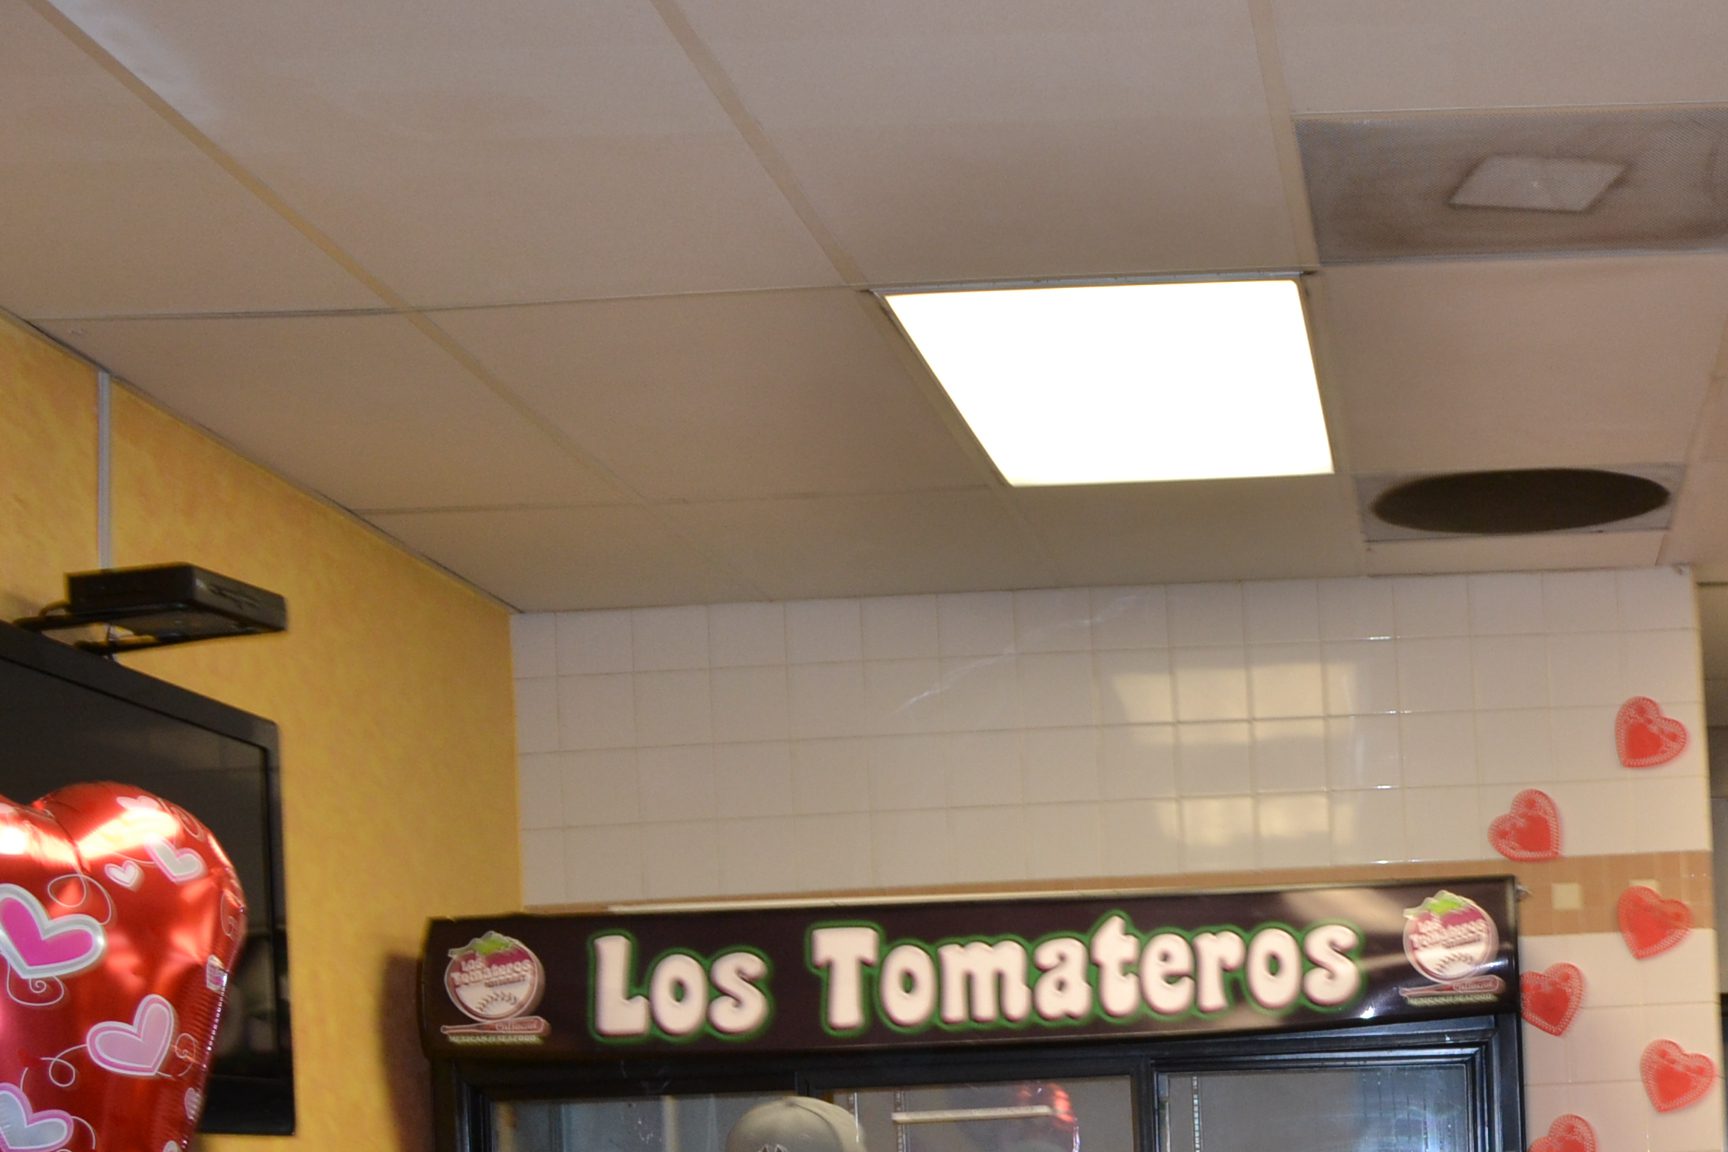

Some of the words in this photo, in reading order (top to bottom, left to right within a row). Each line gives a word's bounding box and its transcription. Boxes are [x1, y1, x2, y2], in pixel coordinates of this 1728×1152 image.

[450, 959, 533, 989] Tomateros
[593, 934, 768, 1035] Los
[811, 914, 1360, 1031] Tomateros
